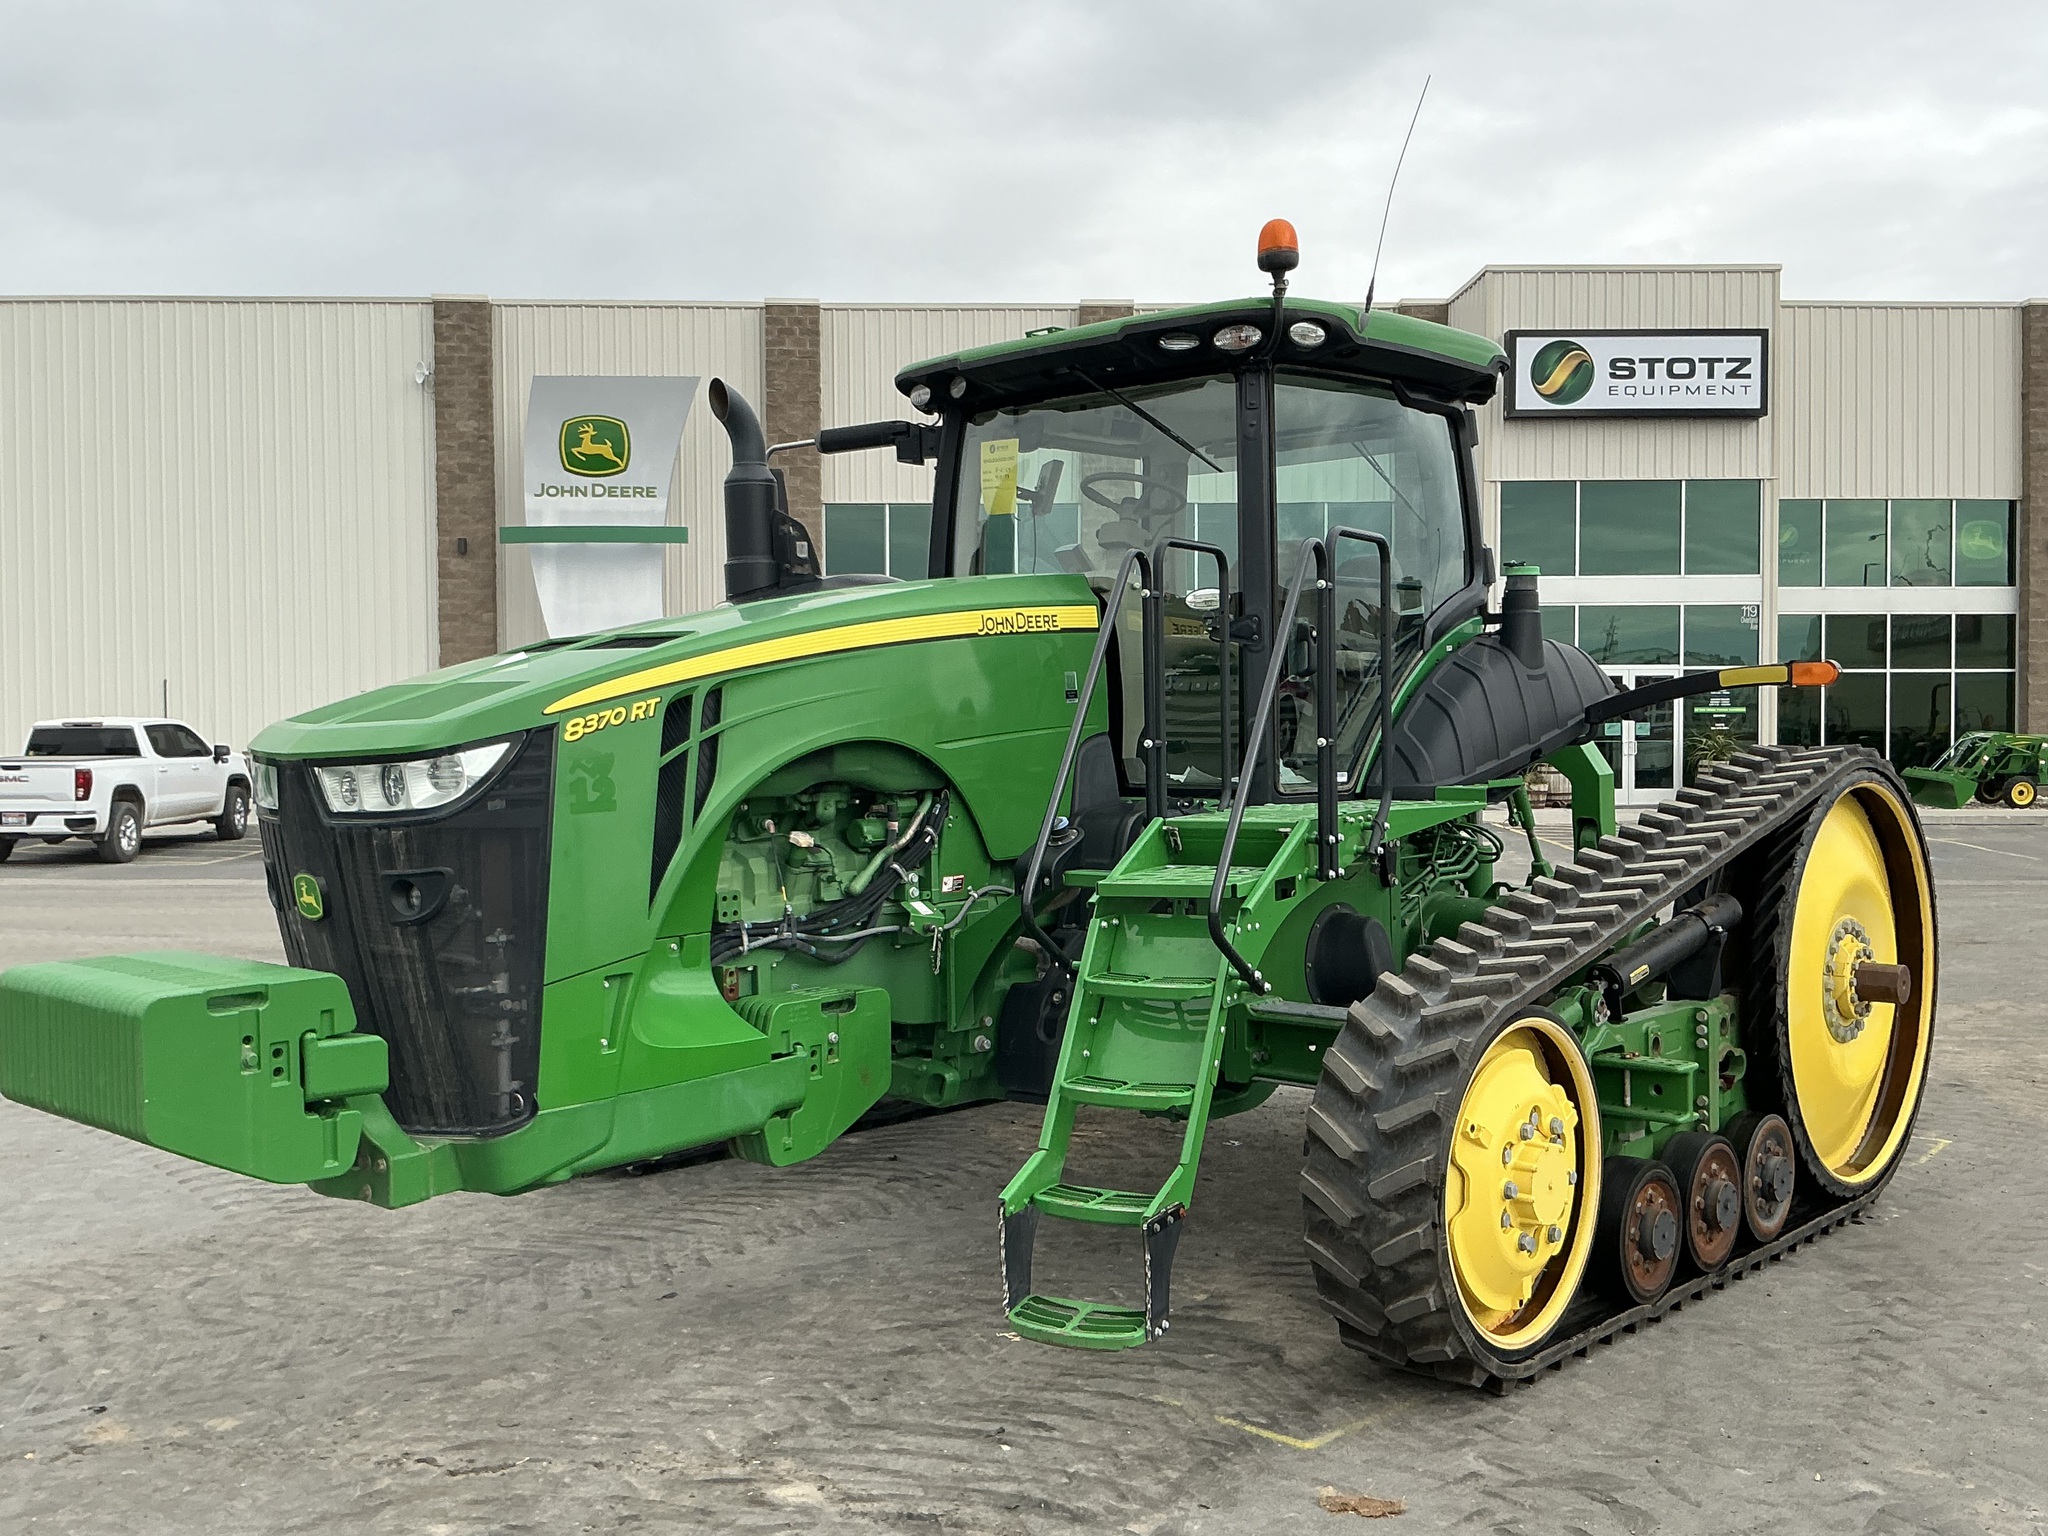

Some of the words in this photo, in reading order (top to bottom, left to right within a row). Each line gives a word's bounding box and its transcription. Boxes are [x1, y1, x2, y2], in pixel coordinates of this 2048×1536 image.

[1609, 357, 1752, 380] STOTZ
[1608, 385, 1752, 397] EQUIPMENT
[534, 483, 588, 498] JOHN
[591, 483, 658, 498] DEERE
[1741, 605, 1758, 618] 119
[978, 614, 1015, 632] JOHN
[1015, 612, 1059, 630] DEERE
[564, 706, 627, 742] 8370
[630, 696, 662, 722] RT
